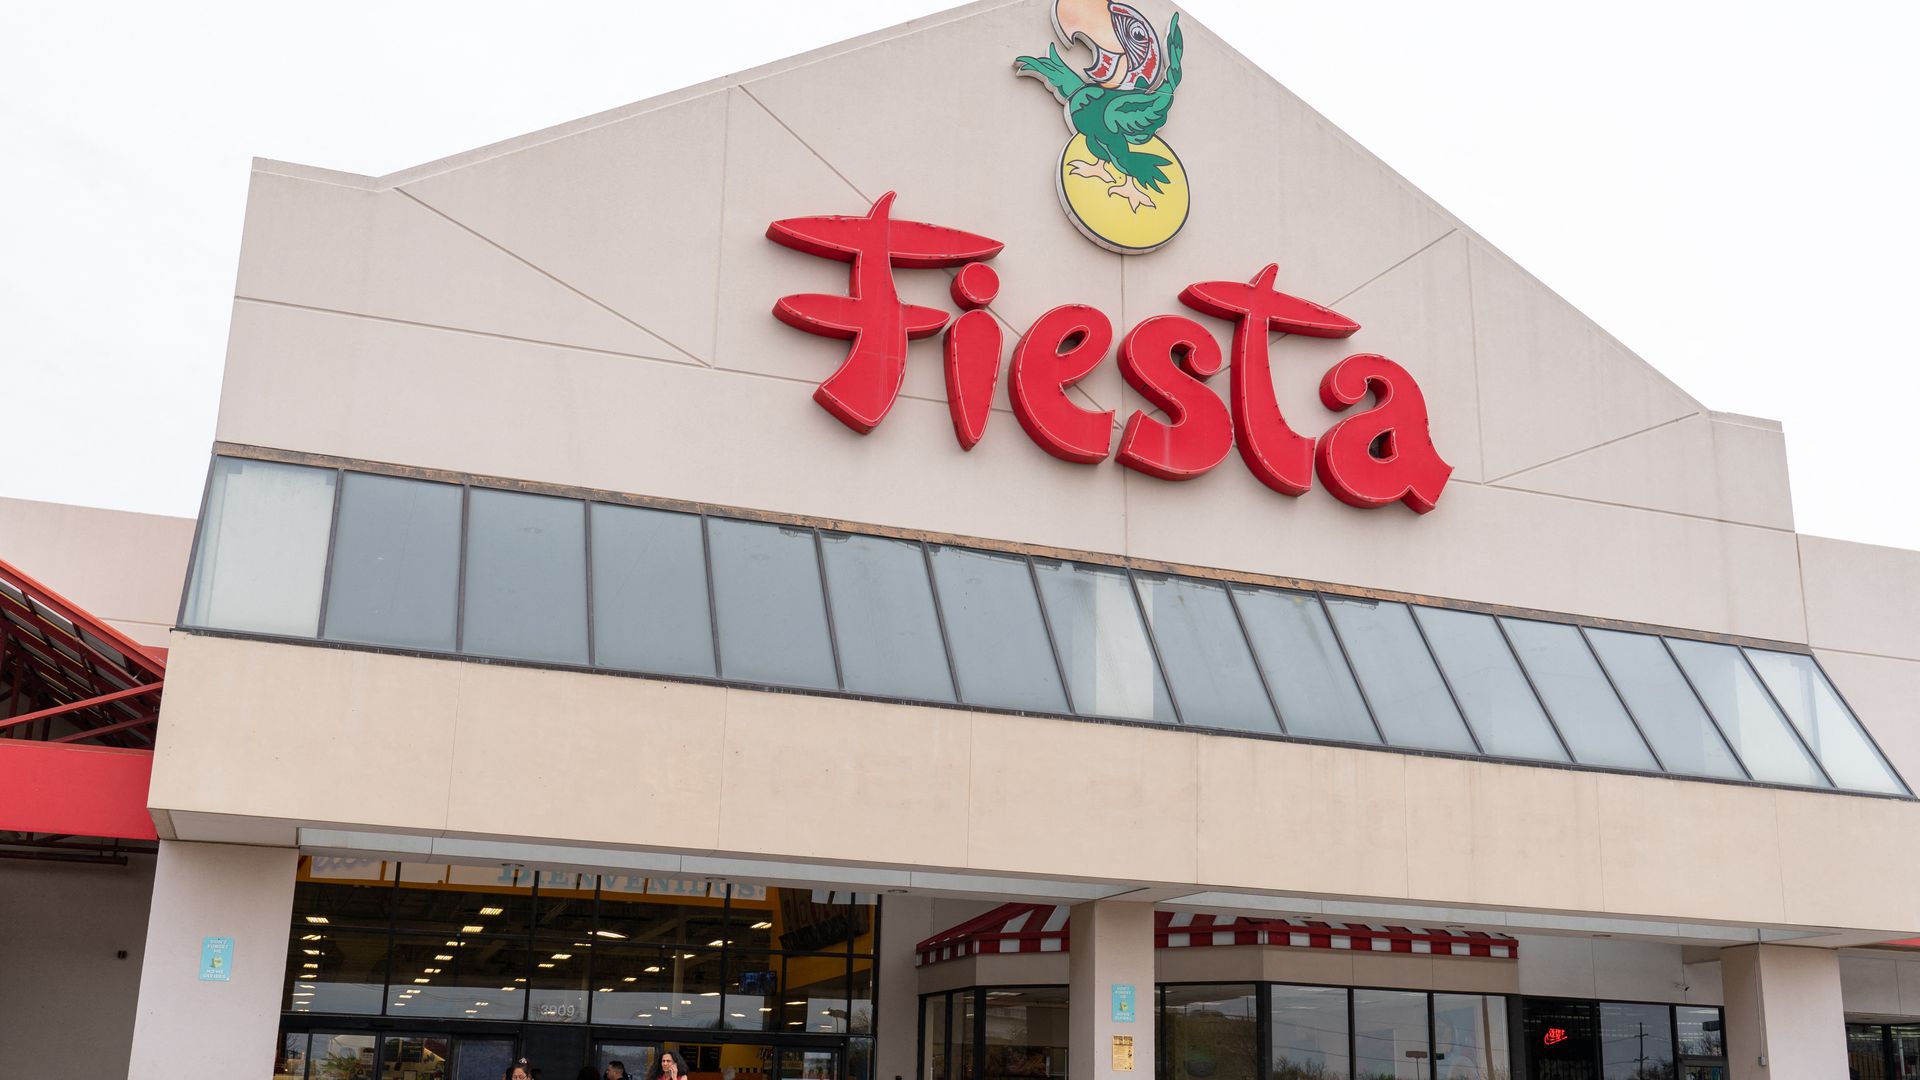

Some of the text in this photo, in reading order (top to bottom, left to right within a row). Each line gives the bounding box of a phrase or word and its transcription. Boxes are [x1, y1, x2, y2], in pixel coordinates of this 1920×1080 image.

[765, 190, 1455, 516] Fiesta
[497, 865, 764, 897] BENVENIDOS
[541, 1004, 575, 1017] 3909
